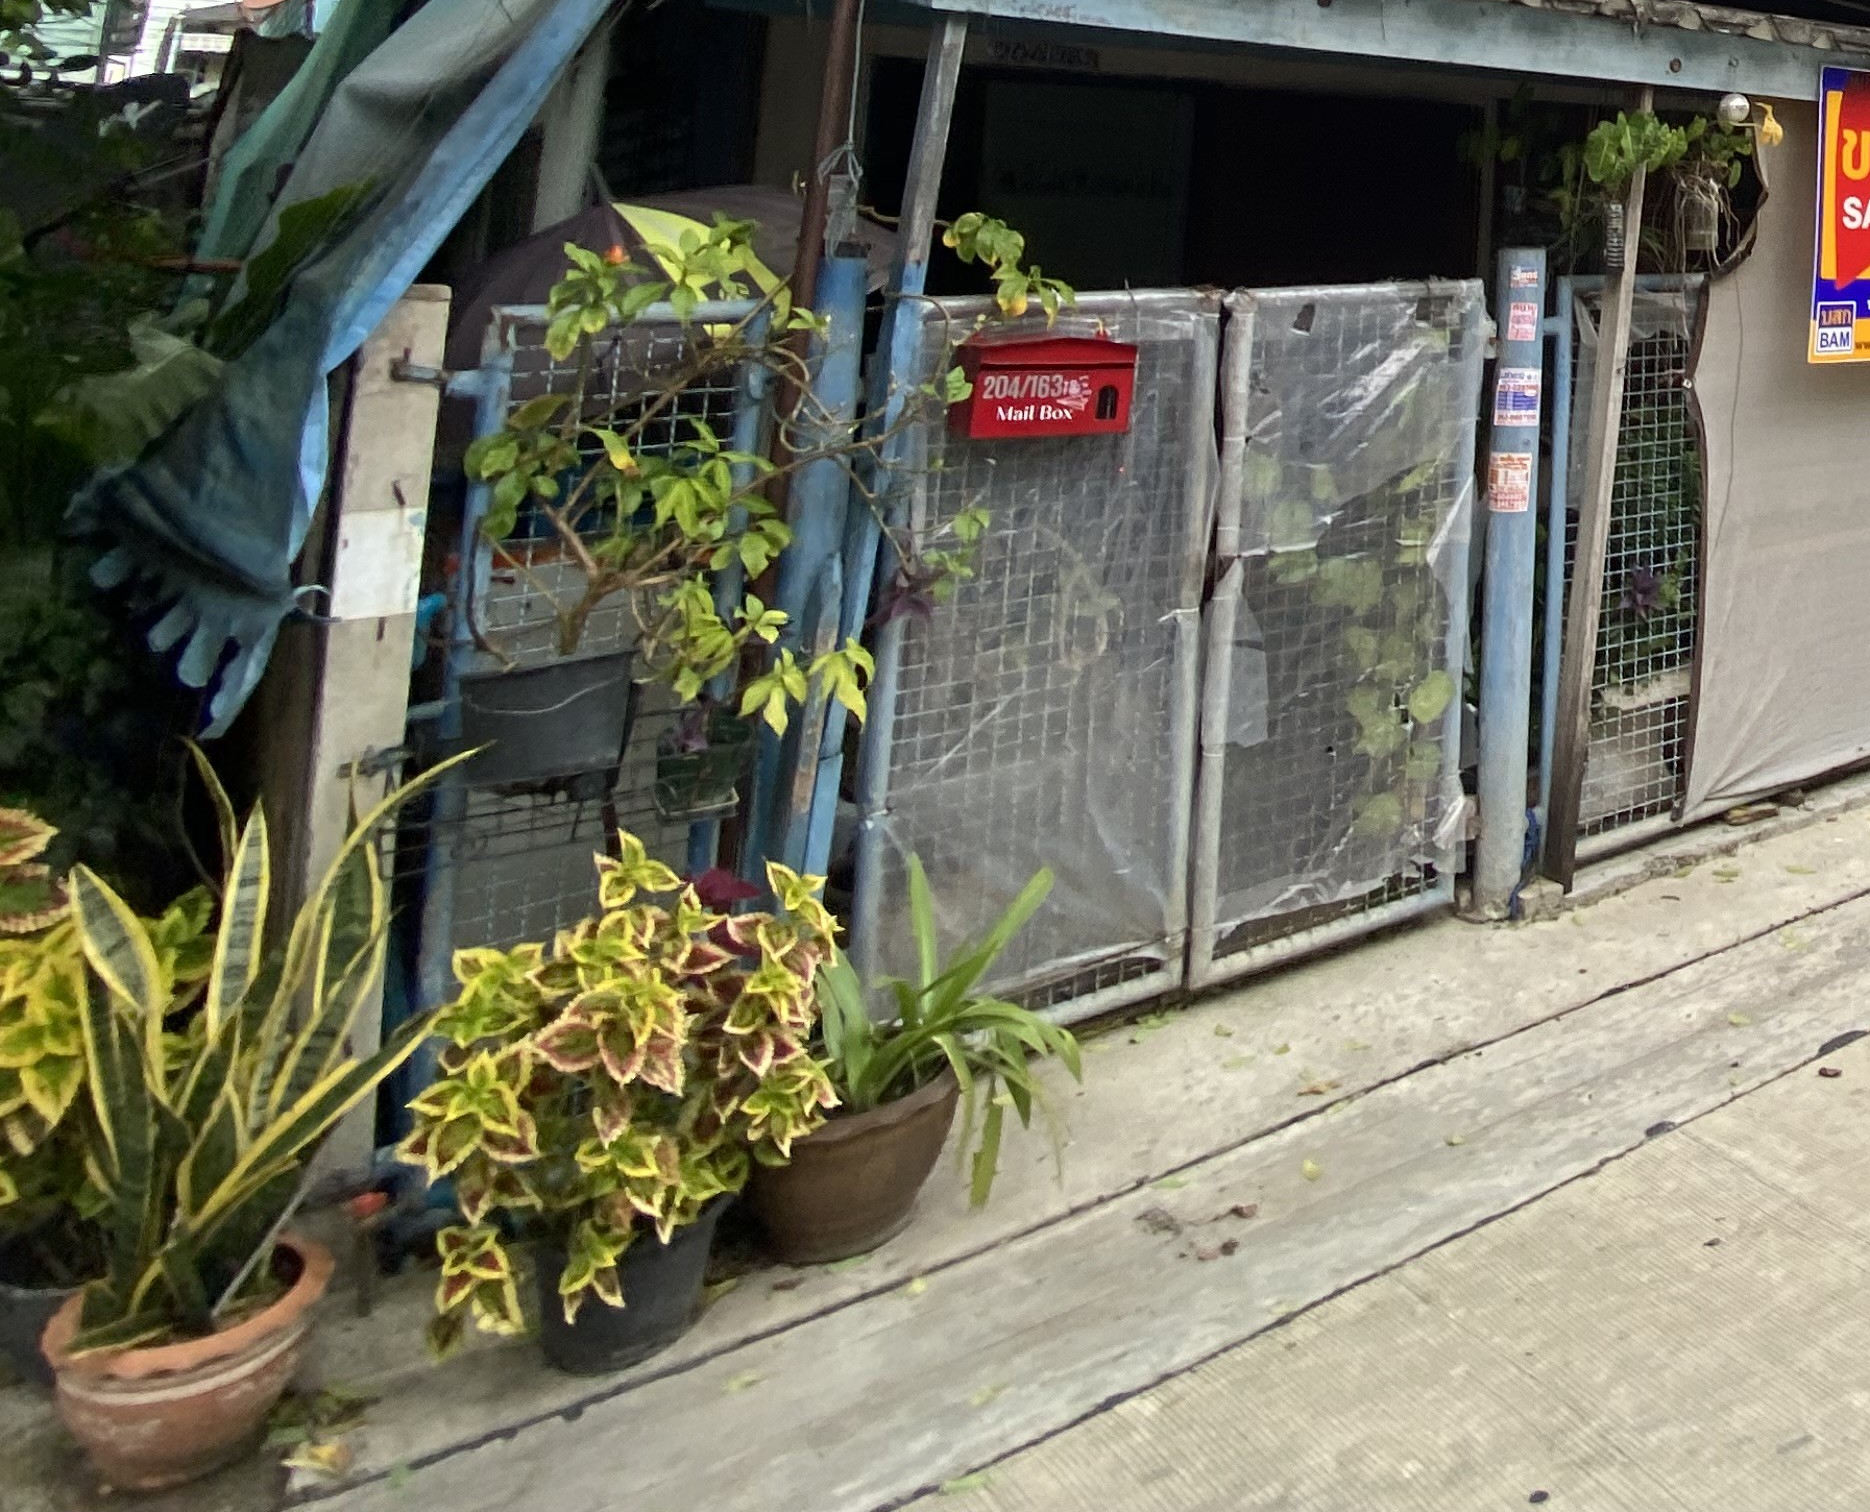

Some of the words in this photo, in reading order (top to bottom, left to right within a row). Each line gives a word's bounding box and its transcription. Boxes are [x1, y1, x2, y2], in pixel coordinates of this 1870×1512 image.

[1820, 331, 1850, 348] BAM
[996, 404, 1035, 421] Mail
[1040, 404, 1073, 420] Box
